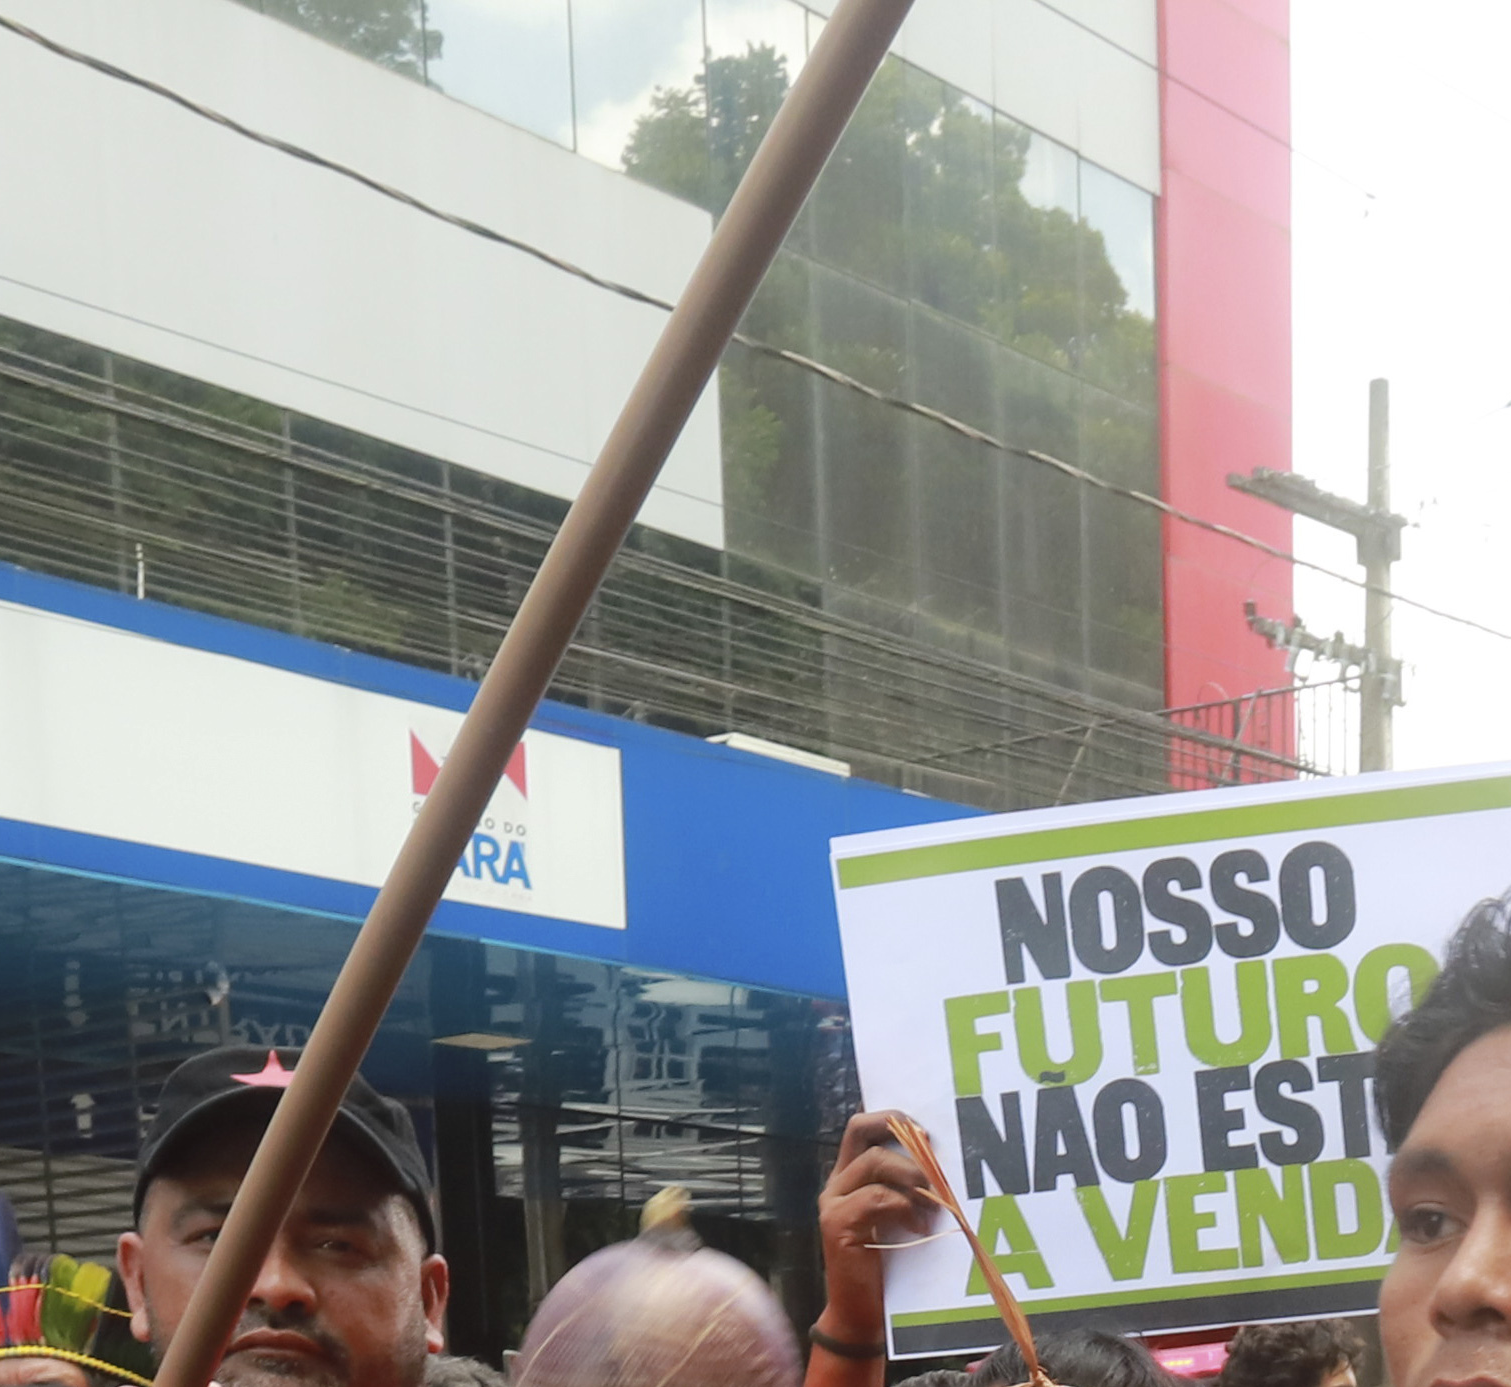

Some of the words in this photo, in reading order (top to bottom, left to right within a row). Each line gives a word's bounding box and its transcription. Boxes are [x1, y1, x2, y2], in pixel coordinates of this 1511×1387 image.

[994, 840, 1357, 985] NOSSO
[943, 943, 1442, 1097] FUTURO
[954, 1071, 1167, 1200] NÃO
[1195, 1051, 1397, 1172] EST
[1076, 1157, 1400, 1282] VEND
